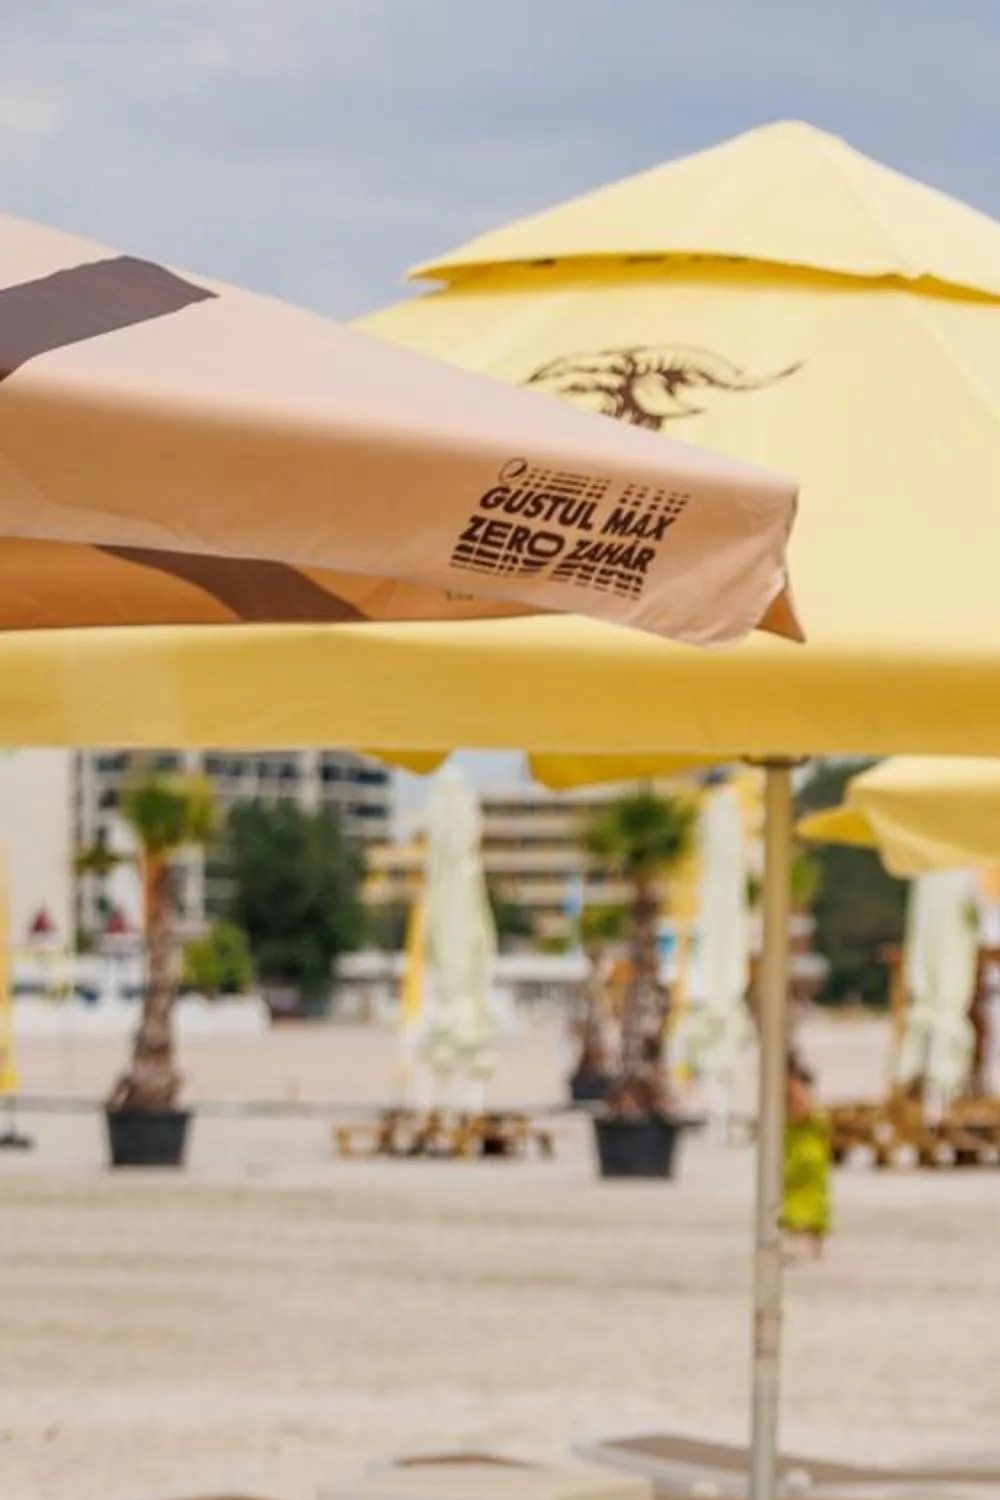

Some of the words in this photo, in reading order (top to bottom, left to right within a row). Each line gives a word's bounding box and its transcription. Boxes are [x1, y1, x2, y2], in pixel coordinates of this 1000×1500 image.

[459, 514, 565, 558] ZERO
[479, 486, 599, 531] GUSTUL
[601, 507, 677, 542] MAX
